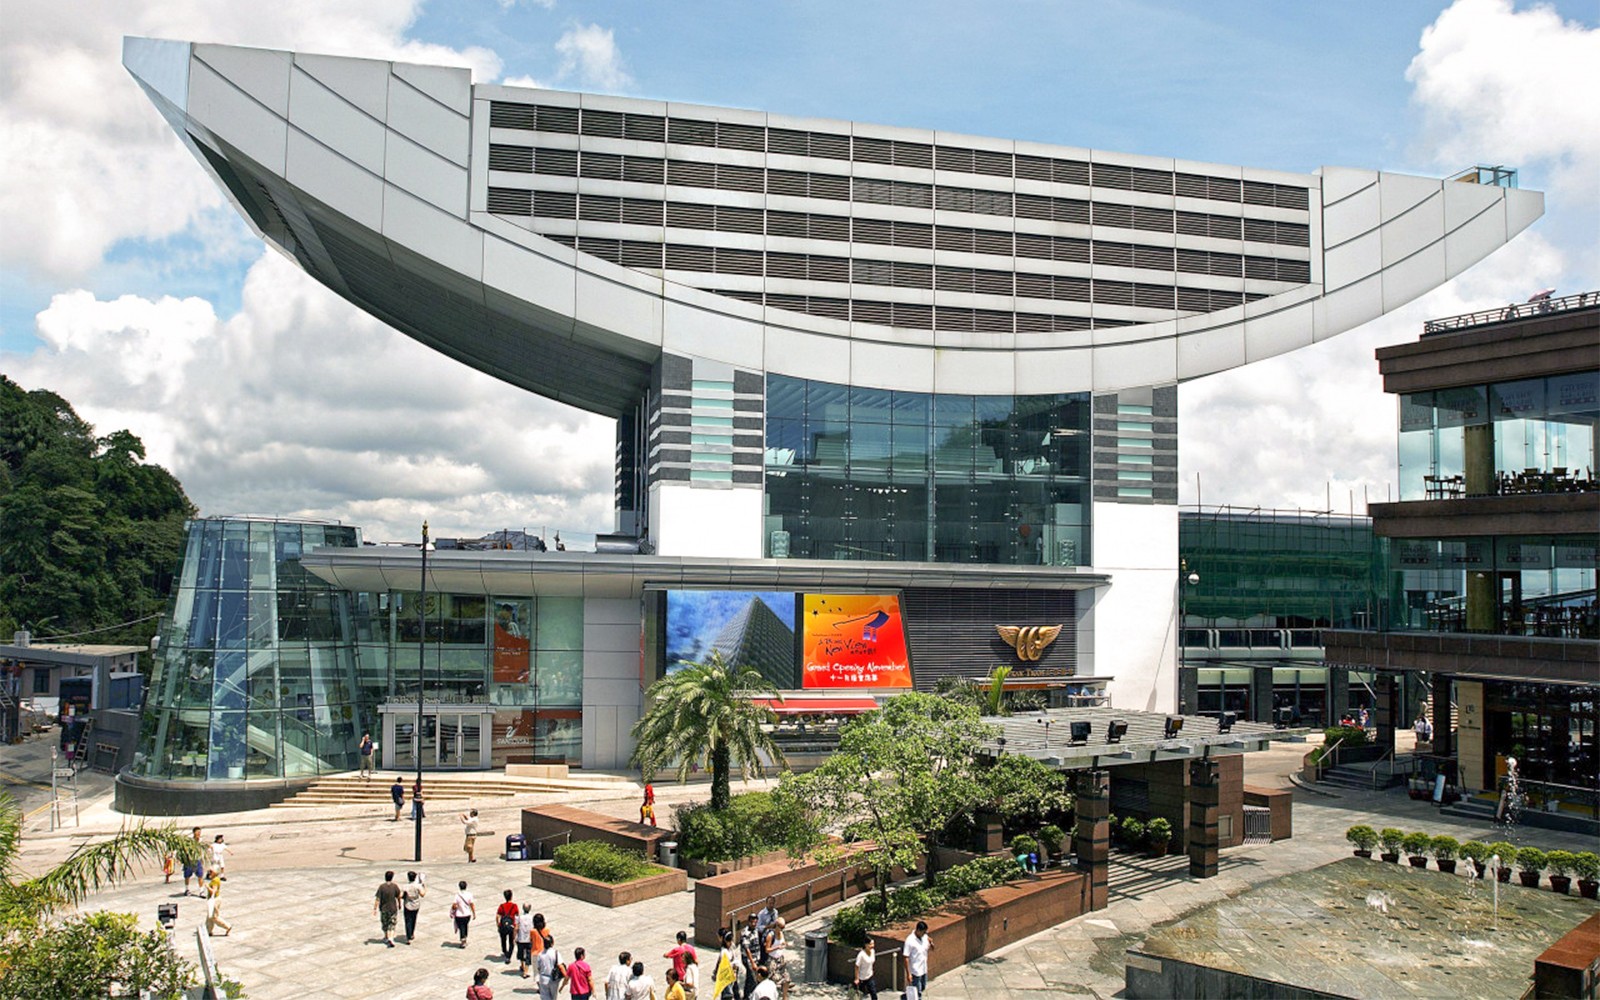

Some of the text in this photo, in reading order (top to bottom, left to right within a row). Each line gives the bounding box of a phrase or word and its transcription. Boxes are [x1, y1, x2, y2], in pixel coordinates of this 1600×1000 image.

[806, 661, 906, 675] Grand Opening November
